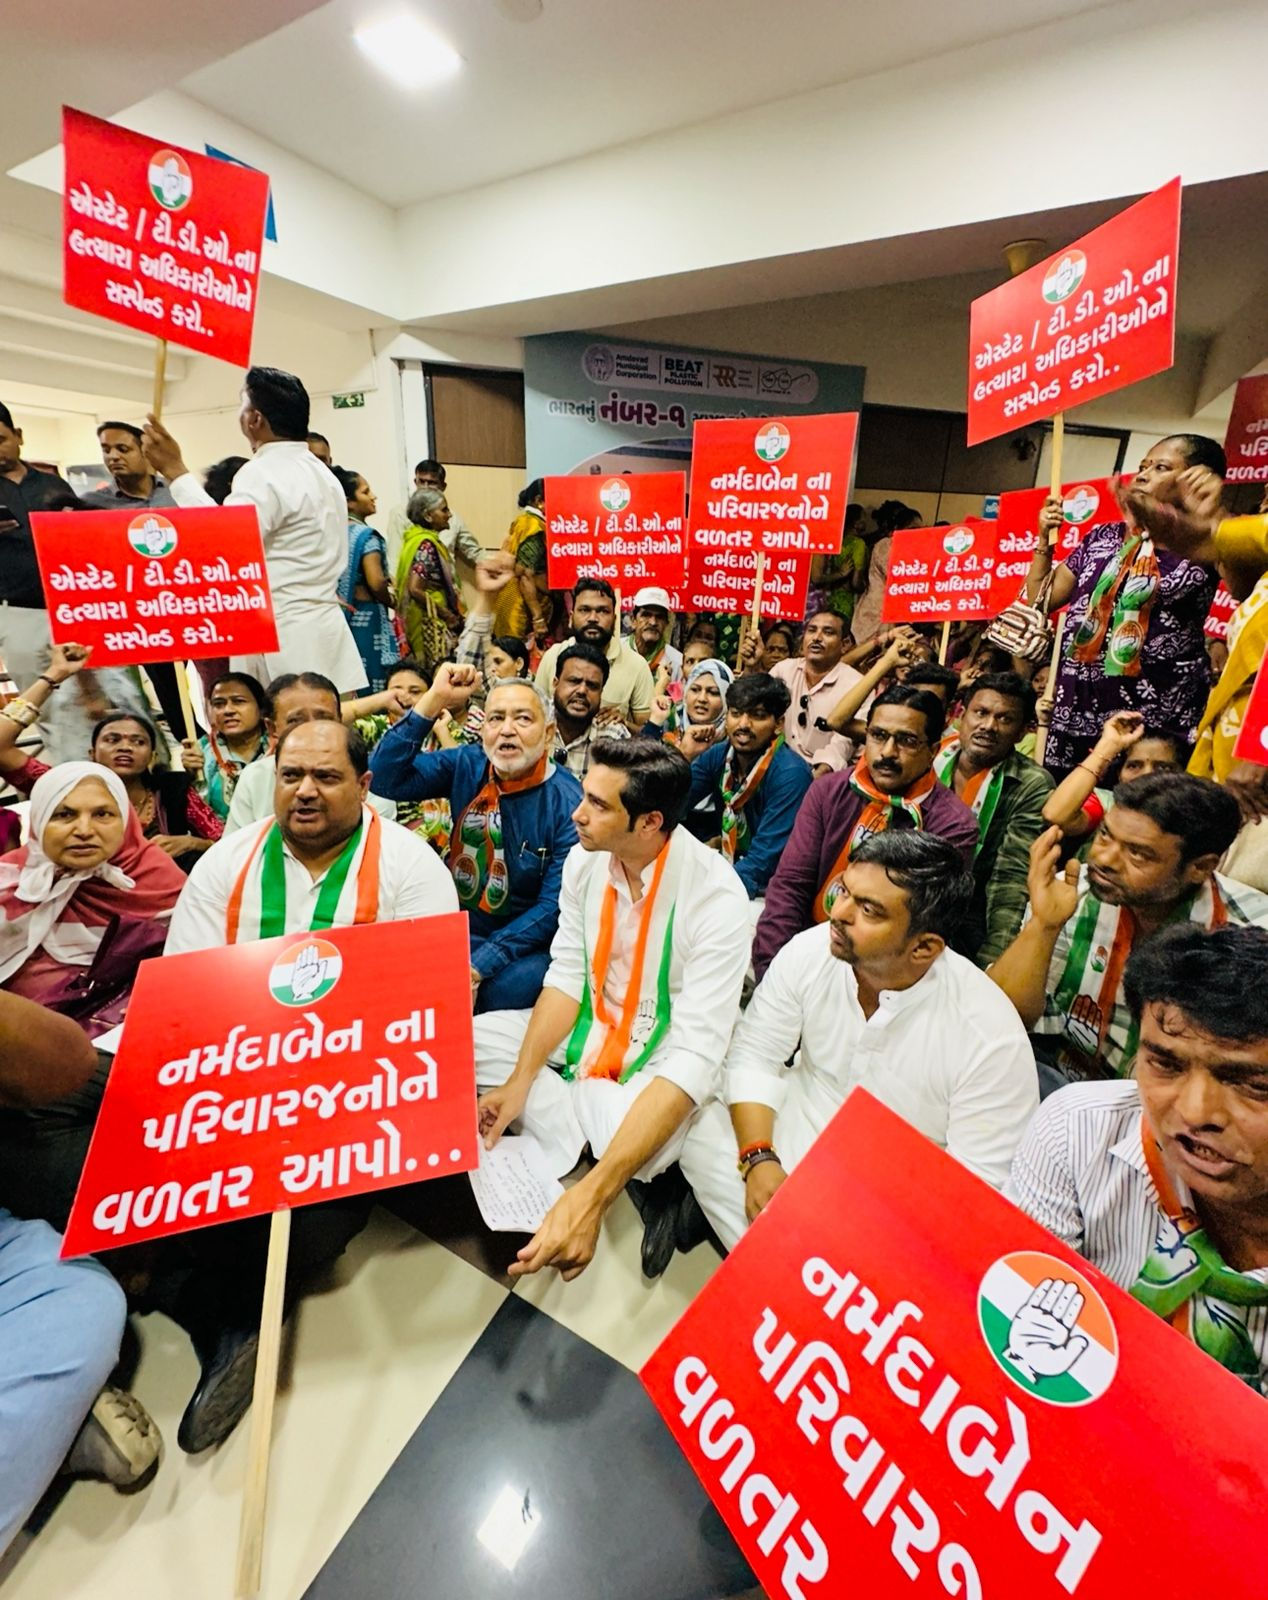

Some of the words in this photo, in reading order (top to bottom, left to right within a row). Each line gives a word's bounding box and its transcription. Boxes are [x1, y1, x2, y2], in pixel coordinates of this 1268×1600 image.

[69, 181, 129, 230] એસ્ટેટ
[135, 208, 146, 240] /
[69, 229, 132, 271] હત્યારા
[139, 252, 251, 312] અધિકારીઓને
[106, 280, 164, 319] સસ્પેન્ડ
[974, 362, 1026, 401] હત્યારા
[1035, 288, 1168, 371] અધિકારીઓને
[975, 333, 1023, 370] એસ્ટેટ
[1031, 320, 1040, 349] /
[616, 362, 648, 371] Municipal
[616, 370, 657, 380] Corporation
[665, 358, 703, 373] BEAT
[670, 372, 699, 380] PLASTIC
[664, 378, 703, 387] POLLUTION
[1003, 380, 1060, 417] સસ્પેન્ડ
[710, 465, 798, 491] નર્મદાબેન
[806, 472, 831, 490] ના
[1225, 464, 1268, 480] વળત
[707, 495, 829, 520] પરિવારજનોને
[550, 514, 588, 534] એસ્ટેટ
[594, 516, 600, 537] /
[695, 529, 753, 546] વળતર
[551, 542, 592, 557] હત્યારા
[598, 534, 682, 555] અધિકારીઓને
[50, 563, 117, 591] એસ્ટેટ
[126, 565, 133, 592] /
[576, 559, 618, 577] સસ્પેન્ડ
[778, 559, 796, 573] ના
[892, 560, 928, 576] એસ્ટેટ
[932, 560, 940, 576] /
[889, 582, 929, 595] હત્યારા
[935, 573, 991, 592] અધિકારી
[55, 600, 128, 624] હત્યારા
[137, 584, 267, 617] અધિકારીઓને
[692, 595, 737, 611] વળતર
[910, 596, 951, 613] સસ્પેન્ડ
[104, 622, 174, 651] સસ્પેન્ડ
[158, 1012, 363, 1087] નર્મદાબેન
[385, 1008, 436, 1044] ના
[142, 1051, 438, 1153] પરિવારજનોને
[92, 1164, 255, 1235] વળતર
[801, 1255, 1102, 1595] નર્મદાબેન
[673, 1355, 829, 1600] વળતર
